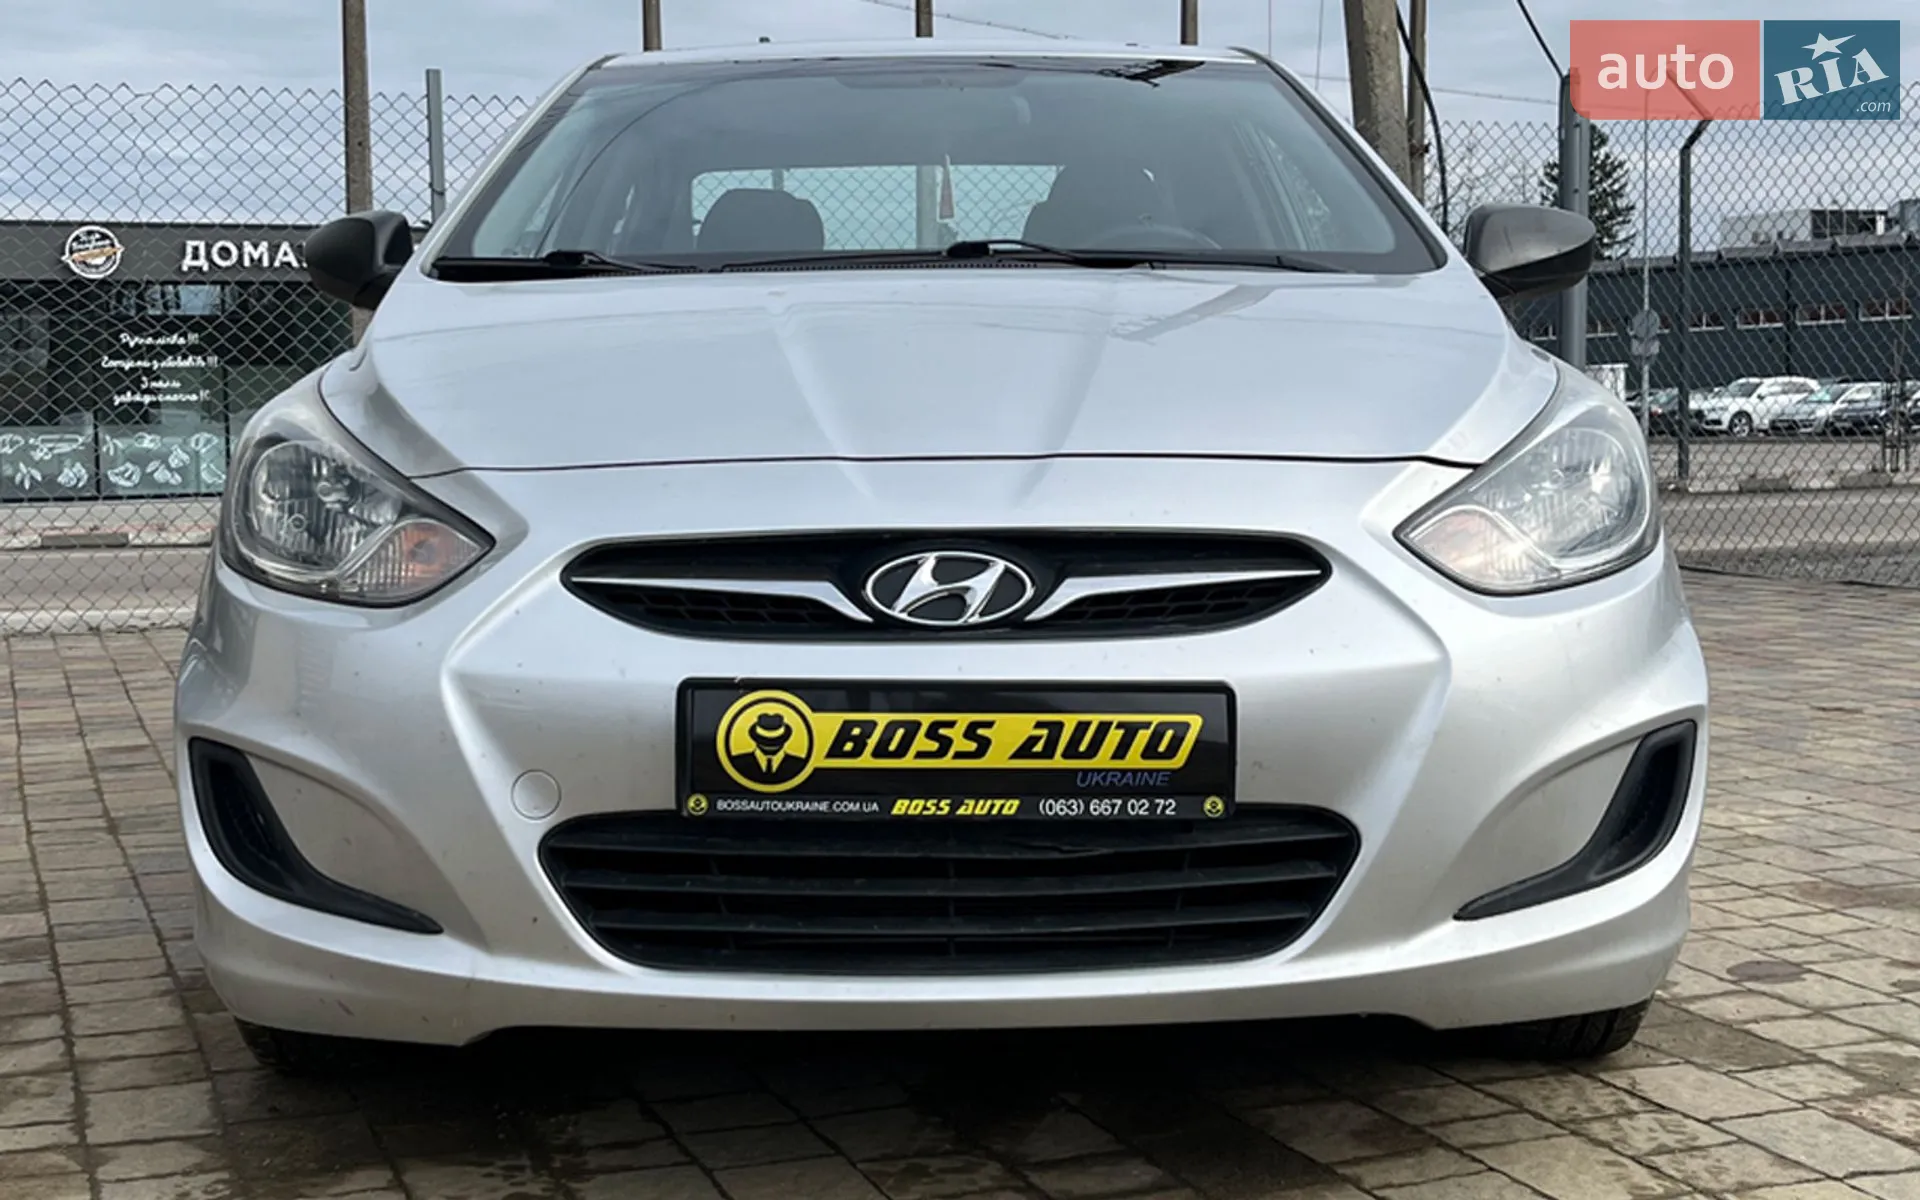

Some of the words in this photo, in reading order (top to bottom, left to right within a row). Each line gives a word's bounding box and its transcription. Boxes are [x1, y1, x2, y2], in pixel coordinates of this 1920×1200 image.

[181, 239, 308, 272] ДОМА
[823, 719, 998, 761] BOSS
[1007, 720, 1191, 761] AUTO
[1075, 771, 1172, 788] UKRAINE
[716, 799, 880, 813] BOSSAUTOUKRAINE.COM.UA
[890, 799, 952, 815] BOSS
[955, 799, 1021, 815] AUTO
[1039, 798, 1085, 816] (063)
[1089, 799, 1121, 815] 667
[1127, 799, 1150, 815] 02
[1156, 799, 1177, 815] 72
